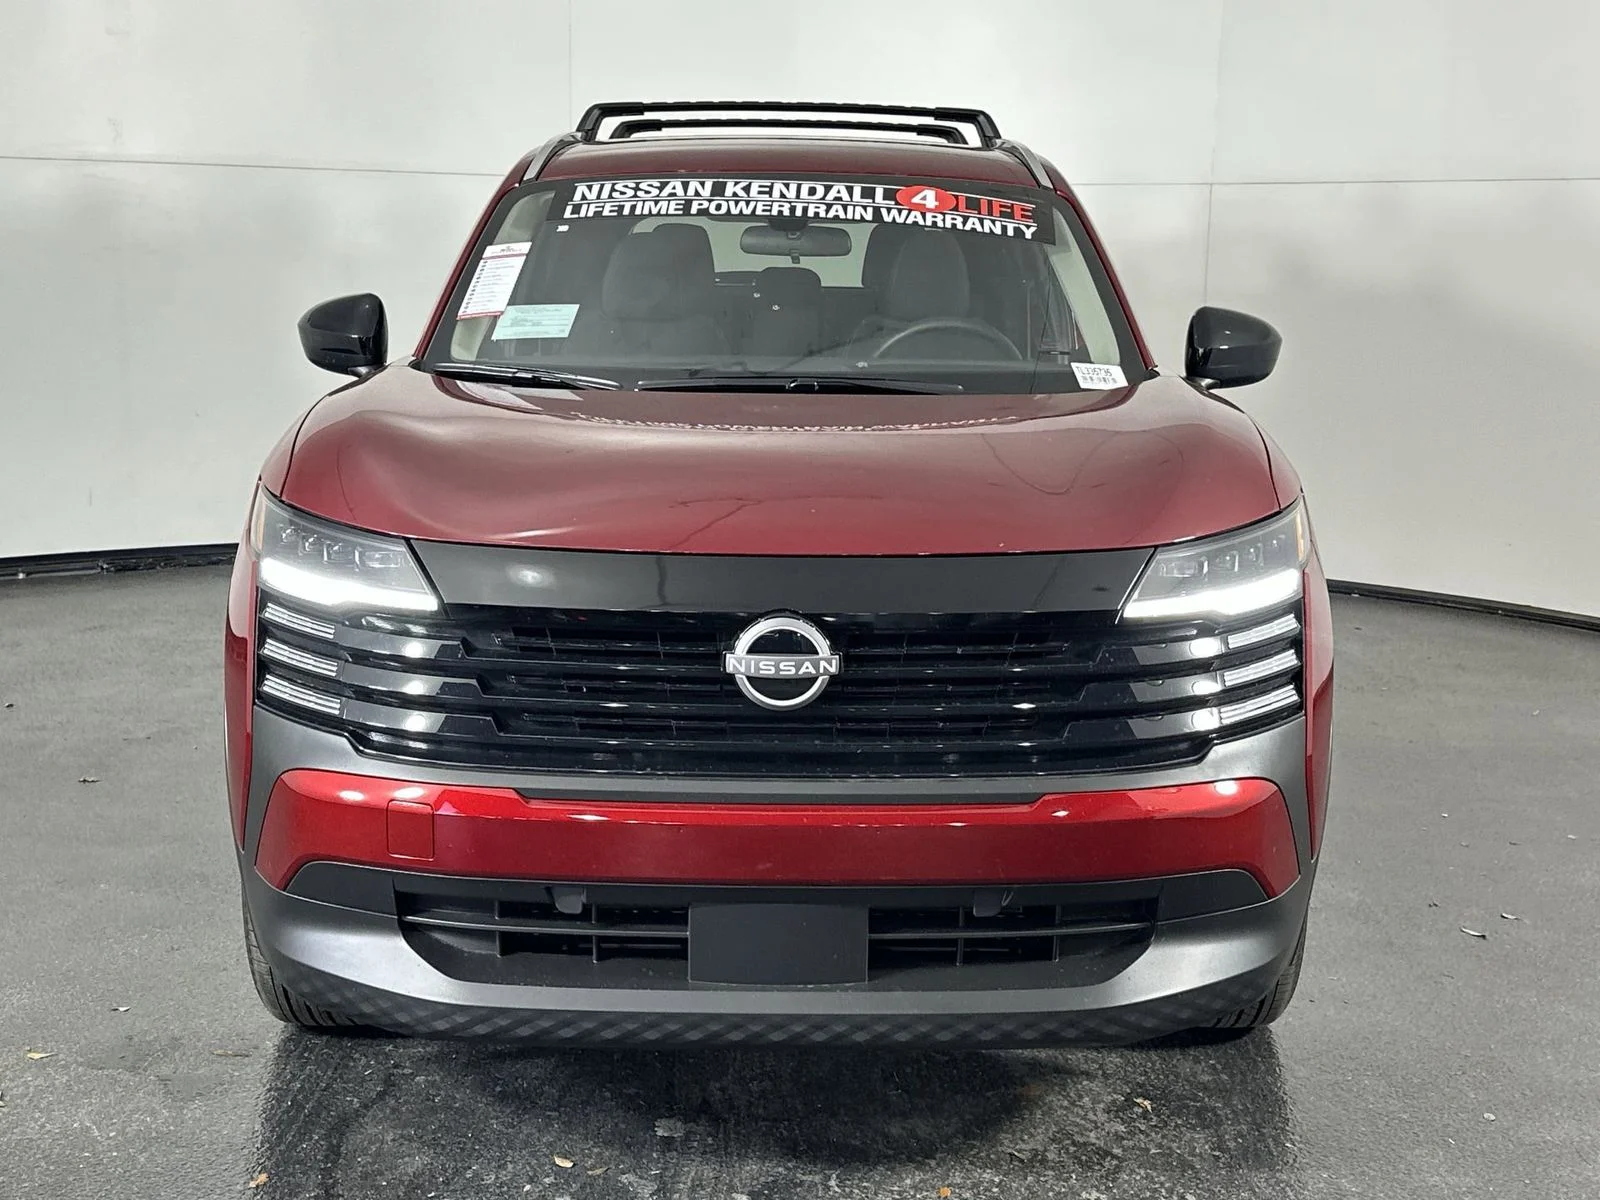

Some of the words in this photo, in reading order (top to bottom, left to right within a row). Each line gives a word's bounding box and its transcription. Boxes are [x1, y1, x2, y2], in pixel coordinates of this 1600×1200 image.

[563, 200, 685, 219] LIFETIME
[690, 200, 873, 221] POWERTRAIN
[880, 207, 1038, 240] WARRANTY
[573, 181, 714, 201] NISSAN
[724, 181, 895, 205] KENDALL
[911, 189, 939, 209] 4
[957, 195, 1034, 223] LIFE
[728, 658, 837, 675] NISSAN
